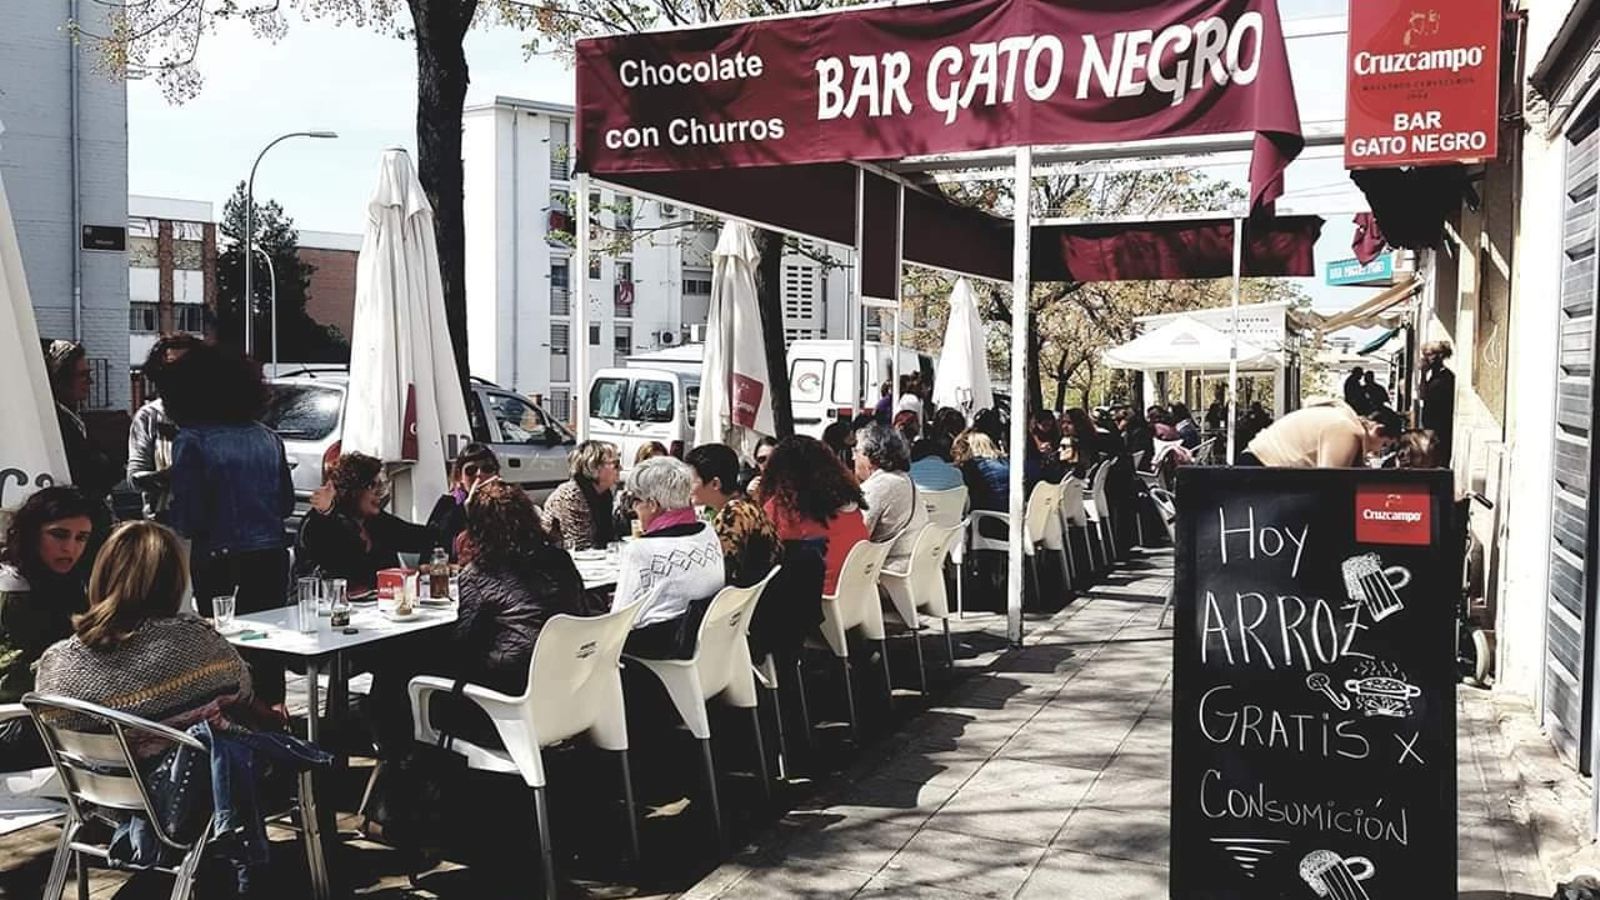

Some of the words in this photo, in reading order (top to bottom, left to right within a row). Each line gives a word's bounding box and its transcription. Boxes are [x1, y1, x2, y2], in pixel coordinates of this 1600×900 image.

[619, 52, 764, 88] Chocolate
[816, 50, 913, 121] BAR
[926, 34, 1063, 125] GATO
[1075, 11, 1264, 107] NEGRO
[1353, 46, 1484, 76] Cruzcampo
[604, 126, 660, 150] con
[667, 116, 786, 146] Churros
[1393, 111, 1442, 132] BAR
[1351, 136, 1406, 157] GATO
[1411, 131, 1487, 153] NEGRO
[1362, 508, 1421, 524] Cruzcampo
[1201, 590, 1376, 672] ARROZ
